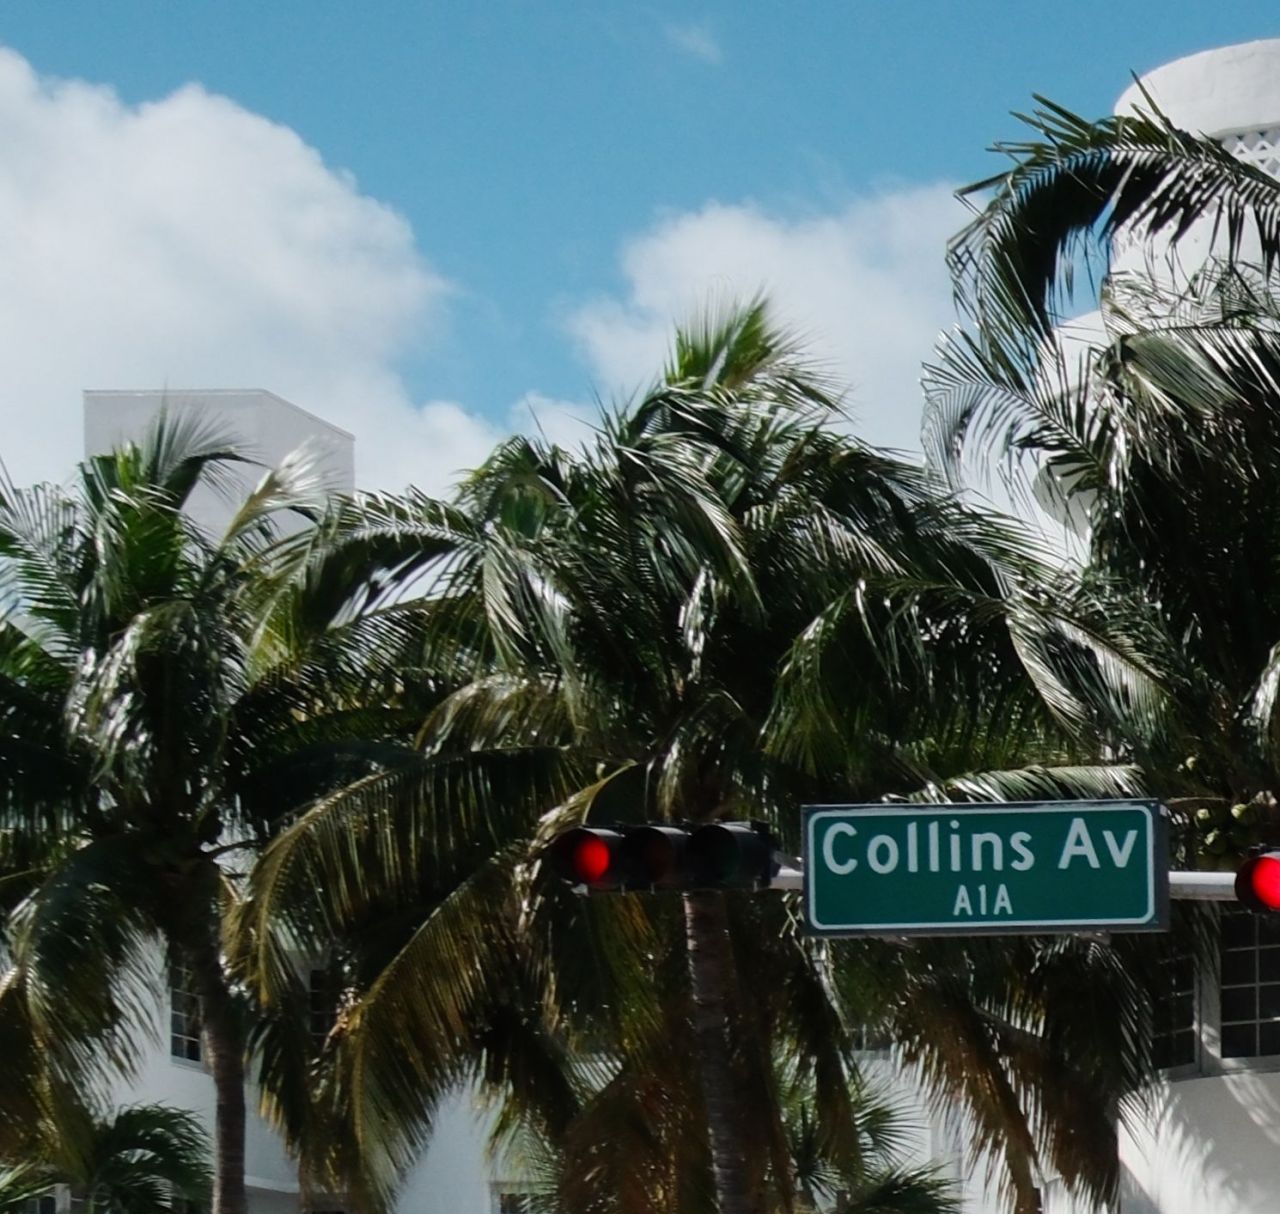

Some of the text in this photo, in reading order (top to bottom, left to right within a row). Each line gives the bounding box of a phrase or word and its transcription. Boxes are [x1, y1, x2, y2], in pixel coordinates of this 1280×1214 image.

[823, 817, 1138, 875] Collins Av
[953, 884, 1013, 916] A1A
